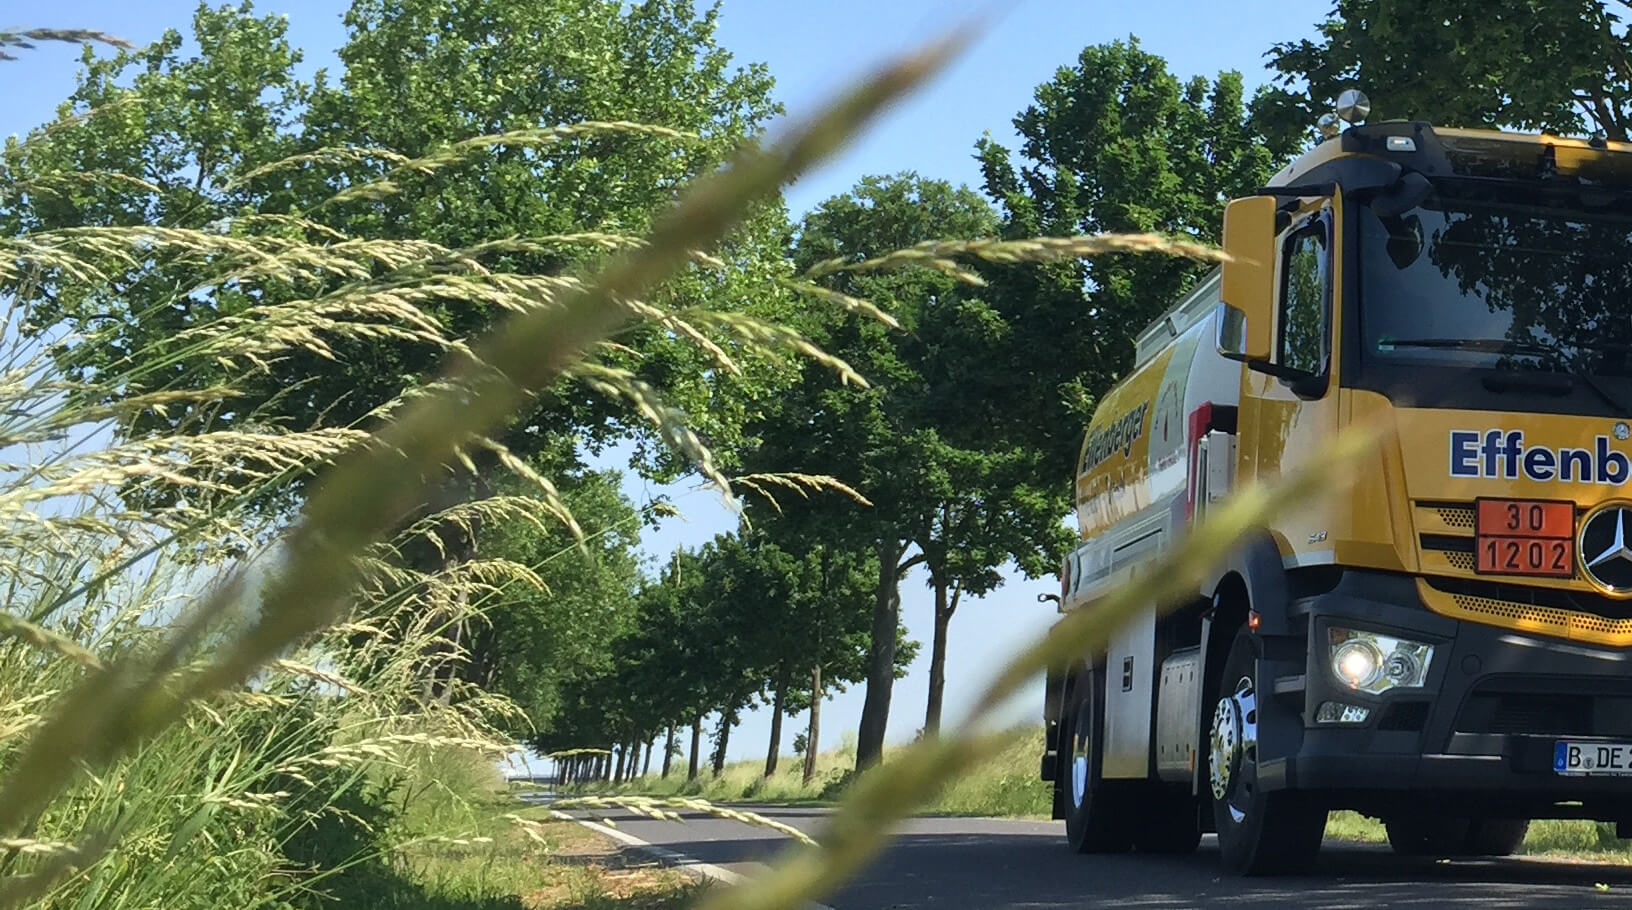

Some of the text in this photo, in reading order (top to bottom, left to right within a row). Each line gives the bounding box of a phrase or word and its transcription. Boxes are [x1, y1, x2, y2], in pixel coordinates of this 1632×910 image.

[1507, 503, 1543, 531] 30
[1487, 541, 1566, 570] 1202
[1569, 746, 1581, 767] B
[1597, 747, 1623, 768] DE
